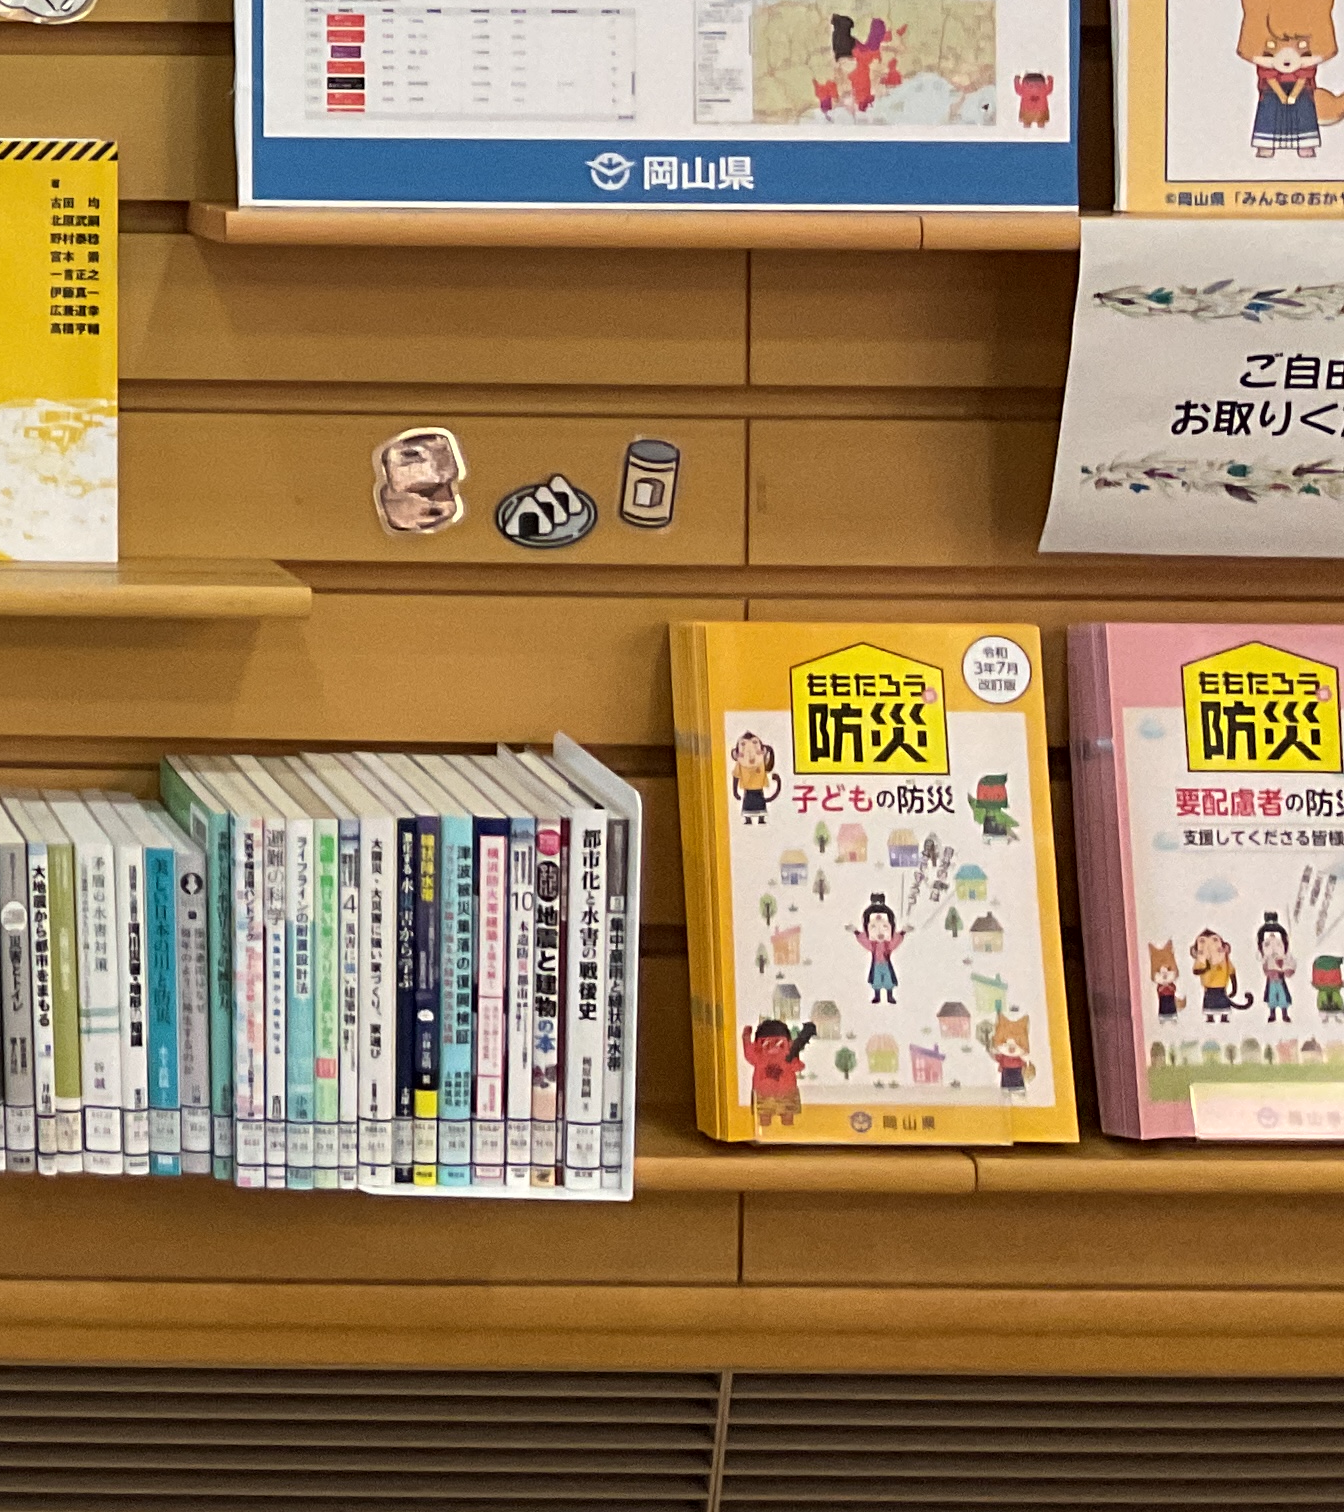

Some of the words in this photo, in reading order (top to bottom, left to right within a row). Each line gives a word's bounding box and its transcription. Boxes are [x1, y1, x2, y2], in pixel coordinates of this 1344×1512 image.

[642, 155, 754, 191] 岡山県
[983, 646, 1008, 659] 令和
[974, 661, 1019, 676] 3年7月
[806, 673, 926, 697] ももたろう
[978, 678, 1016, 691] 改訂版
[1199, 671, 1320, 695] ももたろう
[809, 702, 929, 763] 防災
[1202, 700, 1320, 762] 防災
[791, 785, 955, 814] 子どもの防災
[267, 829, 285, 925] 避難の科学
[343, 894, 356, 914] 4
[511, 891, 534, 912] 10
[579, 829, 601, 1021] 都市化と水害の戦後史
[535, 905, 559, 1054] 地震と建物の本
[883, 1114, 936, 1131] 岡山県
